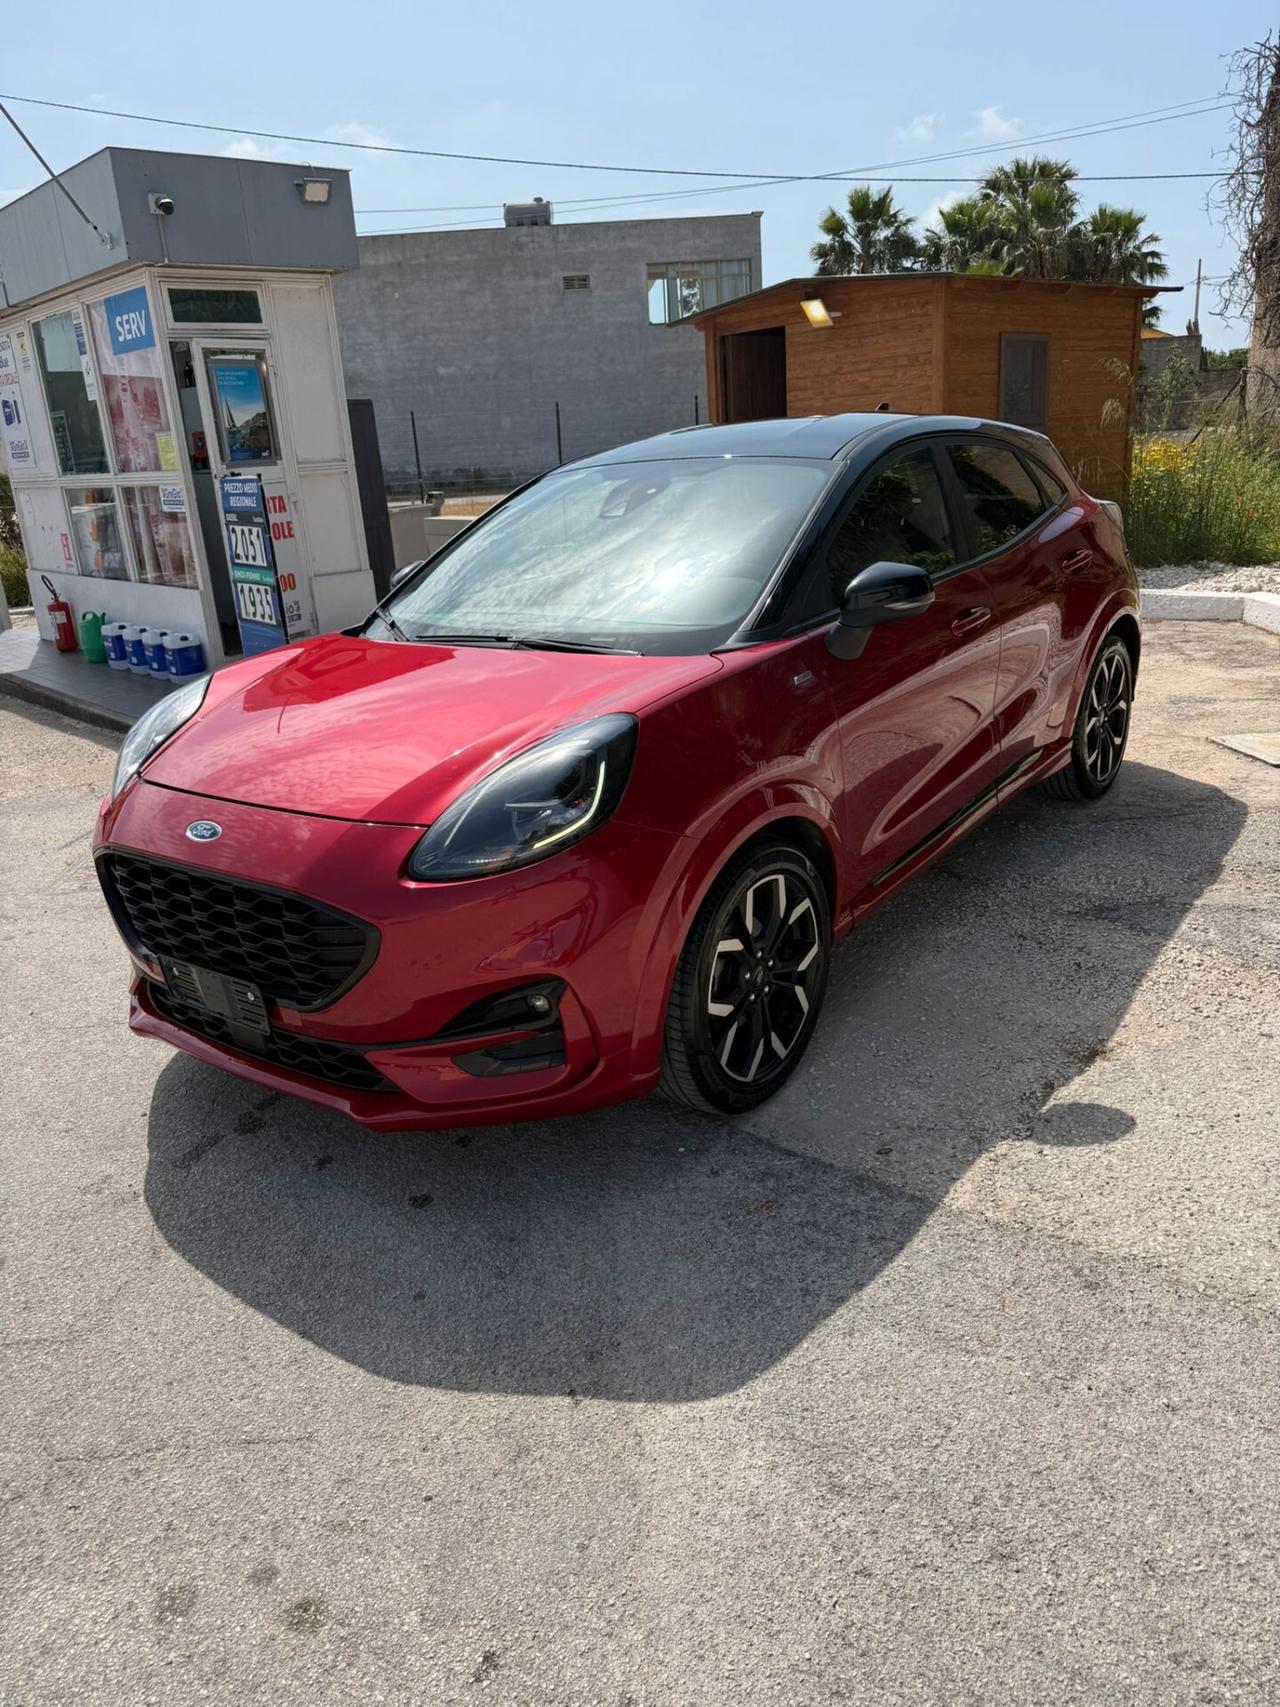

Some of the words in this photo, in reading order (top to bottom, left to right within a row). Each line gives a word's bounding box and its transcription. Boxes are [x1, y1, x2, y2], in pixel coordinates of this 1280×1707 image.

[115, 308, 146, 342] SERV
[223, 482, 243, 494] PREZZO
[229, 495, 257, 508] REGIONALE
[271, 520, 295, 541] OLE
